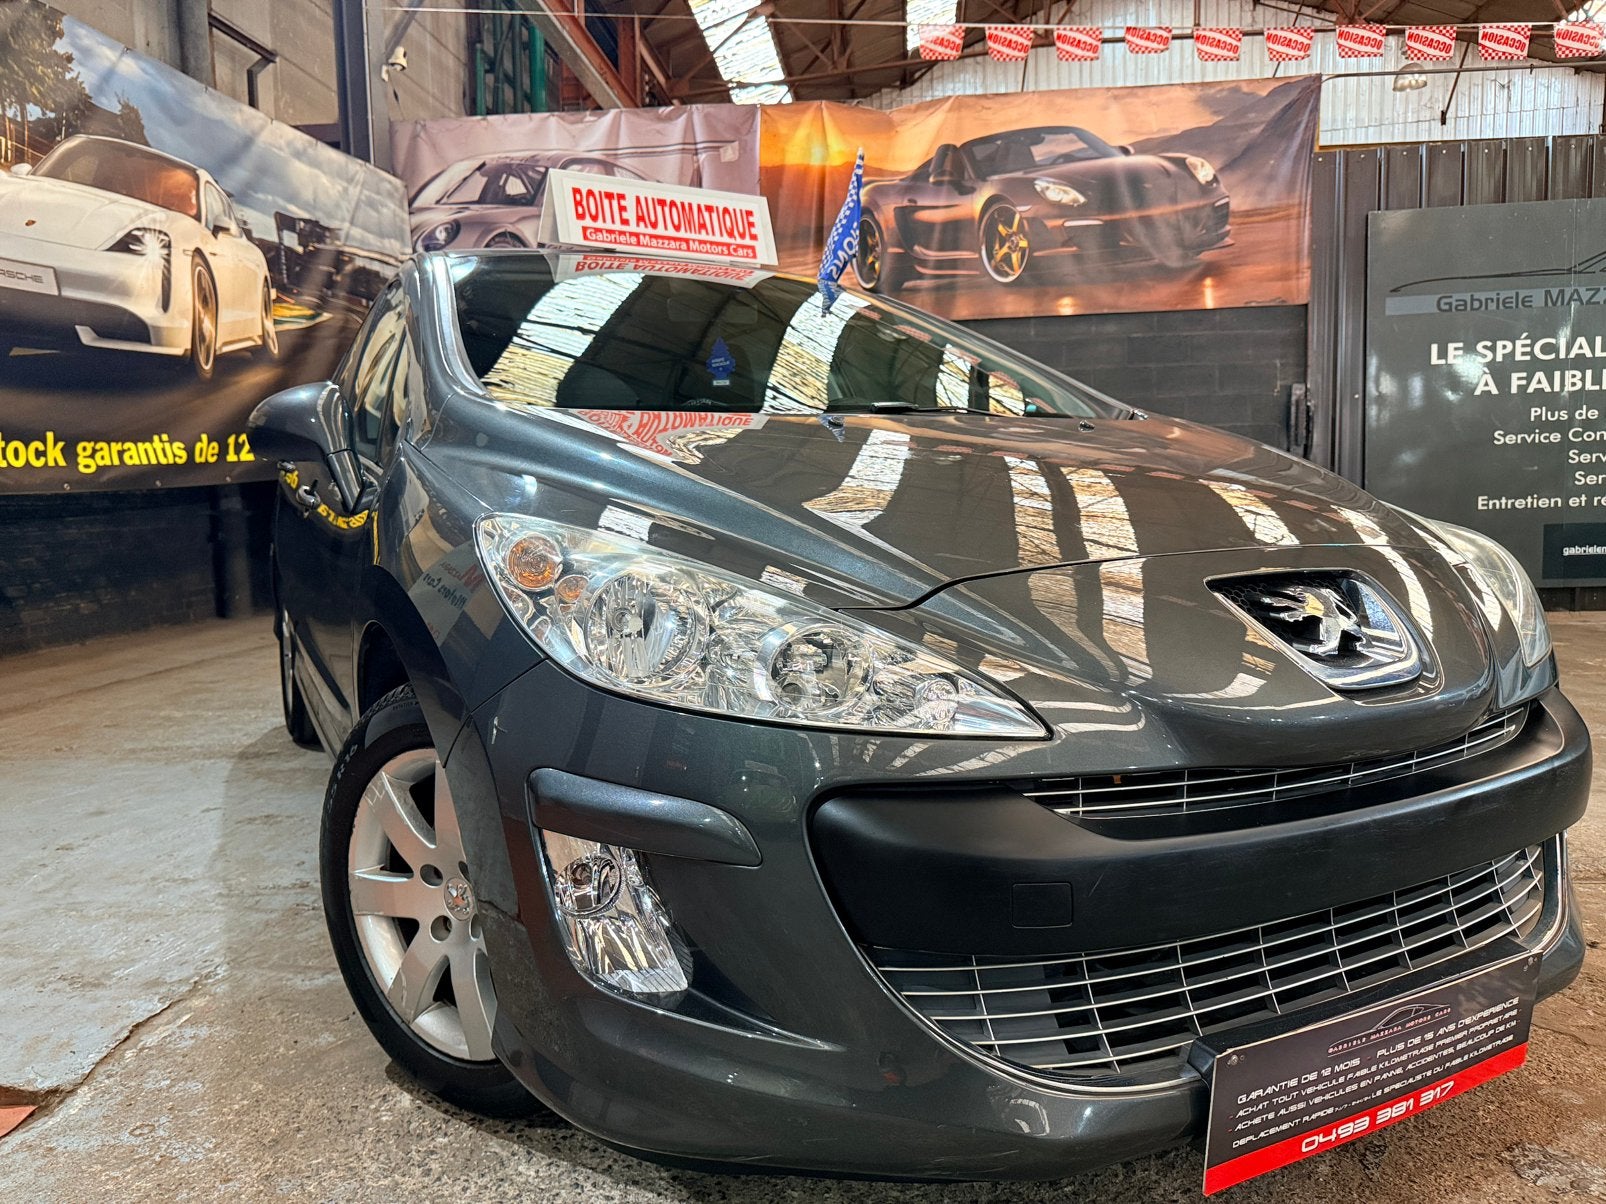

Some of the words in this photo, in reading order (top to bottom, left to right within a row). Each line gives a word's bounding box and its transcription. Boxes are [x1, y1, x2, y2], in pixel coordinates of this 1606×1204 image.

[572, 187, 630, 226] BOITE
[635, 195, 758, 241] AUTOMATIQUE
[586, 229, 637, 245] Gabriele
[640, 234, 687, 251] Mazzara
[689, 241, 728, 256] Motors
[730, 246, 754, 258] Cars
[1436, 292, 1533, 313] Gabriele
[1544, 287, 1606, 307] MAZ
[1430, 342, 1464, 365] LE
[1476, 332, 1606, 363] SPÉCIAL
[1474, 367, 1499, 396] À
[1530, 407, 1568, 422] Plus
[1575, 405, 1599, 420] de
[76, 433, 188, 474] garantis
[194, 433, 219, 463] de
[226, 433, 255, 462] 12
[1493, 430, 1562, 445] Service
[1574, 471, 1606, 485] Ser
[1477, 494, 1562, 510] Entretien
[1568, 494, 1587, 507] et
[1235, 1101, 1270, 1118] ACHAT
[1272, 1091, 1299, 1105] TOUT
[1301, 1077, 1345, 1096] VEHICULE
[1347, 1065, 1377, 1080] FAIBLE
[1379, 1045, 1434, 1069] KILOMETRAGE
[1435, 1029, 1468, 1048] PREMIER
[1235, 1112, 1275, 1131] ACHETE
[1277, 1101, 1306, 1116] AUSSI
[1309, 1083, 1359, 1105] VEHICULES
[1360, 1077, 1373, 1088] EN
[1456, 1029, 1494, 1051] BEAUCOUP
[1495, 1025, 1505, 1033] DE
[1505, 1020, 1516, 1029] KM
[1237, 1077, 1299, 1105] GARANTIE
[1301, 1071, 1318, 1085] DE
[1320, 1067, 1332, 1077] 12
[1334, 1058, 1360, 1073] MOIS
[1377, 1042, 1405, 1058] PLUS
[1407, 1035, 1422, 1048] DE
[1423, 1031, 1434, 1042] 15
[1436, 1023, 1456, 1037] ANS
[1232, 1118, 1301, 1148] DEPLACEMENT
[1302, 1107, 1335, 1123] RAPIDE
[1372, 1089, 1382, 1098] LE
[1383, 1071, 1432, 1093] SPECIALISTE
[1433, 1064, 1444, 1074] DU
[1469, 1034, 1514, 1059] KILOMETRAGE
[1301, 1116, 1370, 1152] 0493
[1376, 1098, 1414, 1123] 381
[1419, 1081, 1454, 1106] 317
